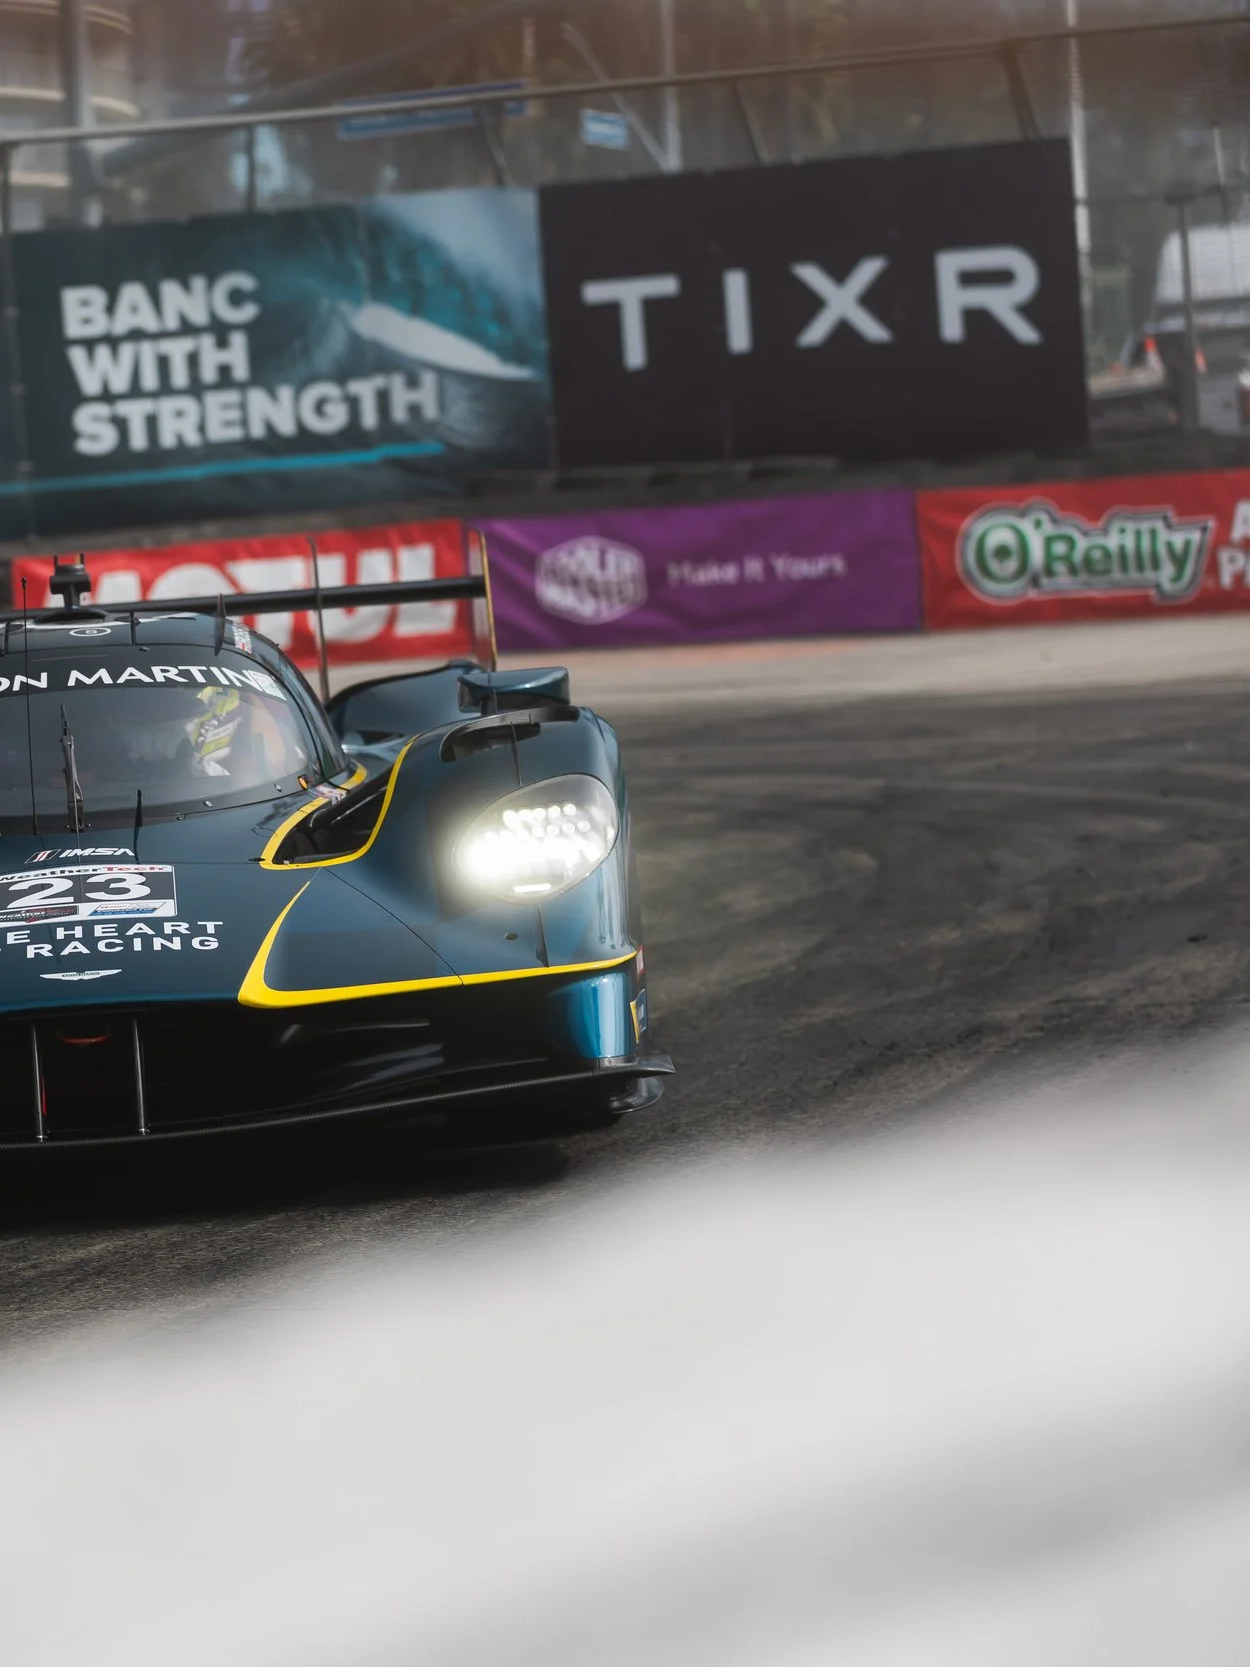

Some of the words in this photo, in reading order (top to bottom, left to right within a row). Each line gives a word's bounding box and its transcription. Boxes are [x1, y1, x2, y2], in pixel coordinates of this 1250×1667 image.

[60, 271, 260, 339] BANC
[581, 243, 1043, 371] TIXR
[66, 329, 250, 397] WITH
[72, 370, 440, 456] STRENGTH
[967, 508, 1202, 593] O'Reilly
[666, 560, 739, 588] Make
[769, 551, 847, 581] Yours
[67, 665, 264, 693] MARTIN
[59, 847, 135, 858] IMSA
[7, 873, 151, 909] 23
[26, 937, 220, 958] RACING
[56, 921, 223, 940] HEART
